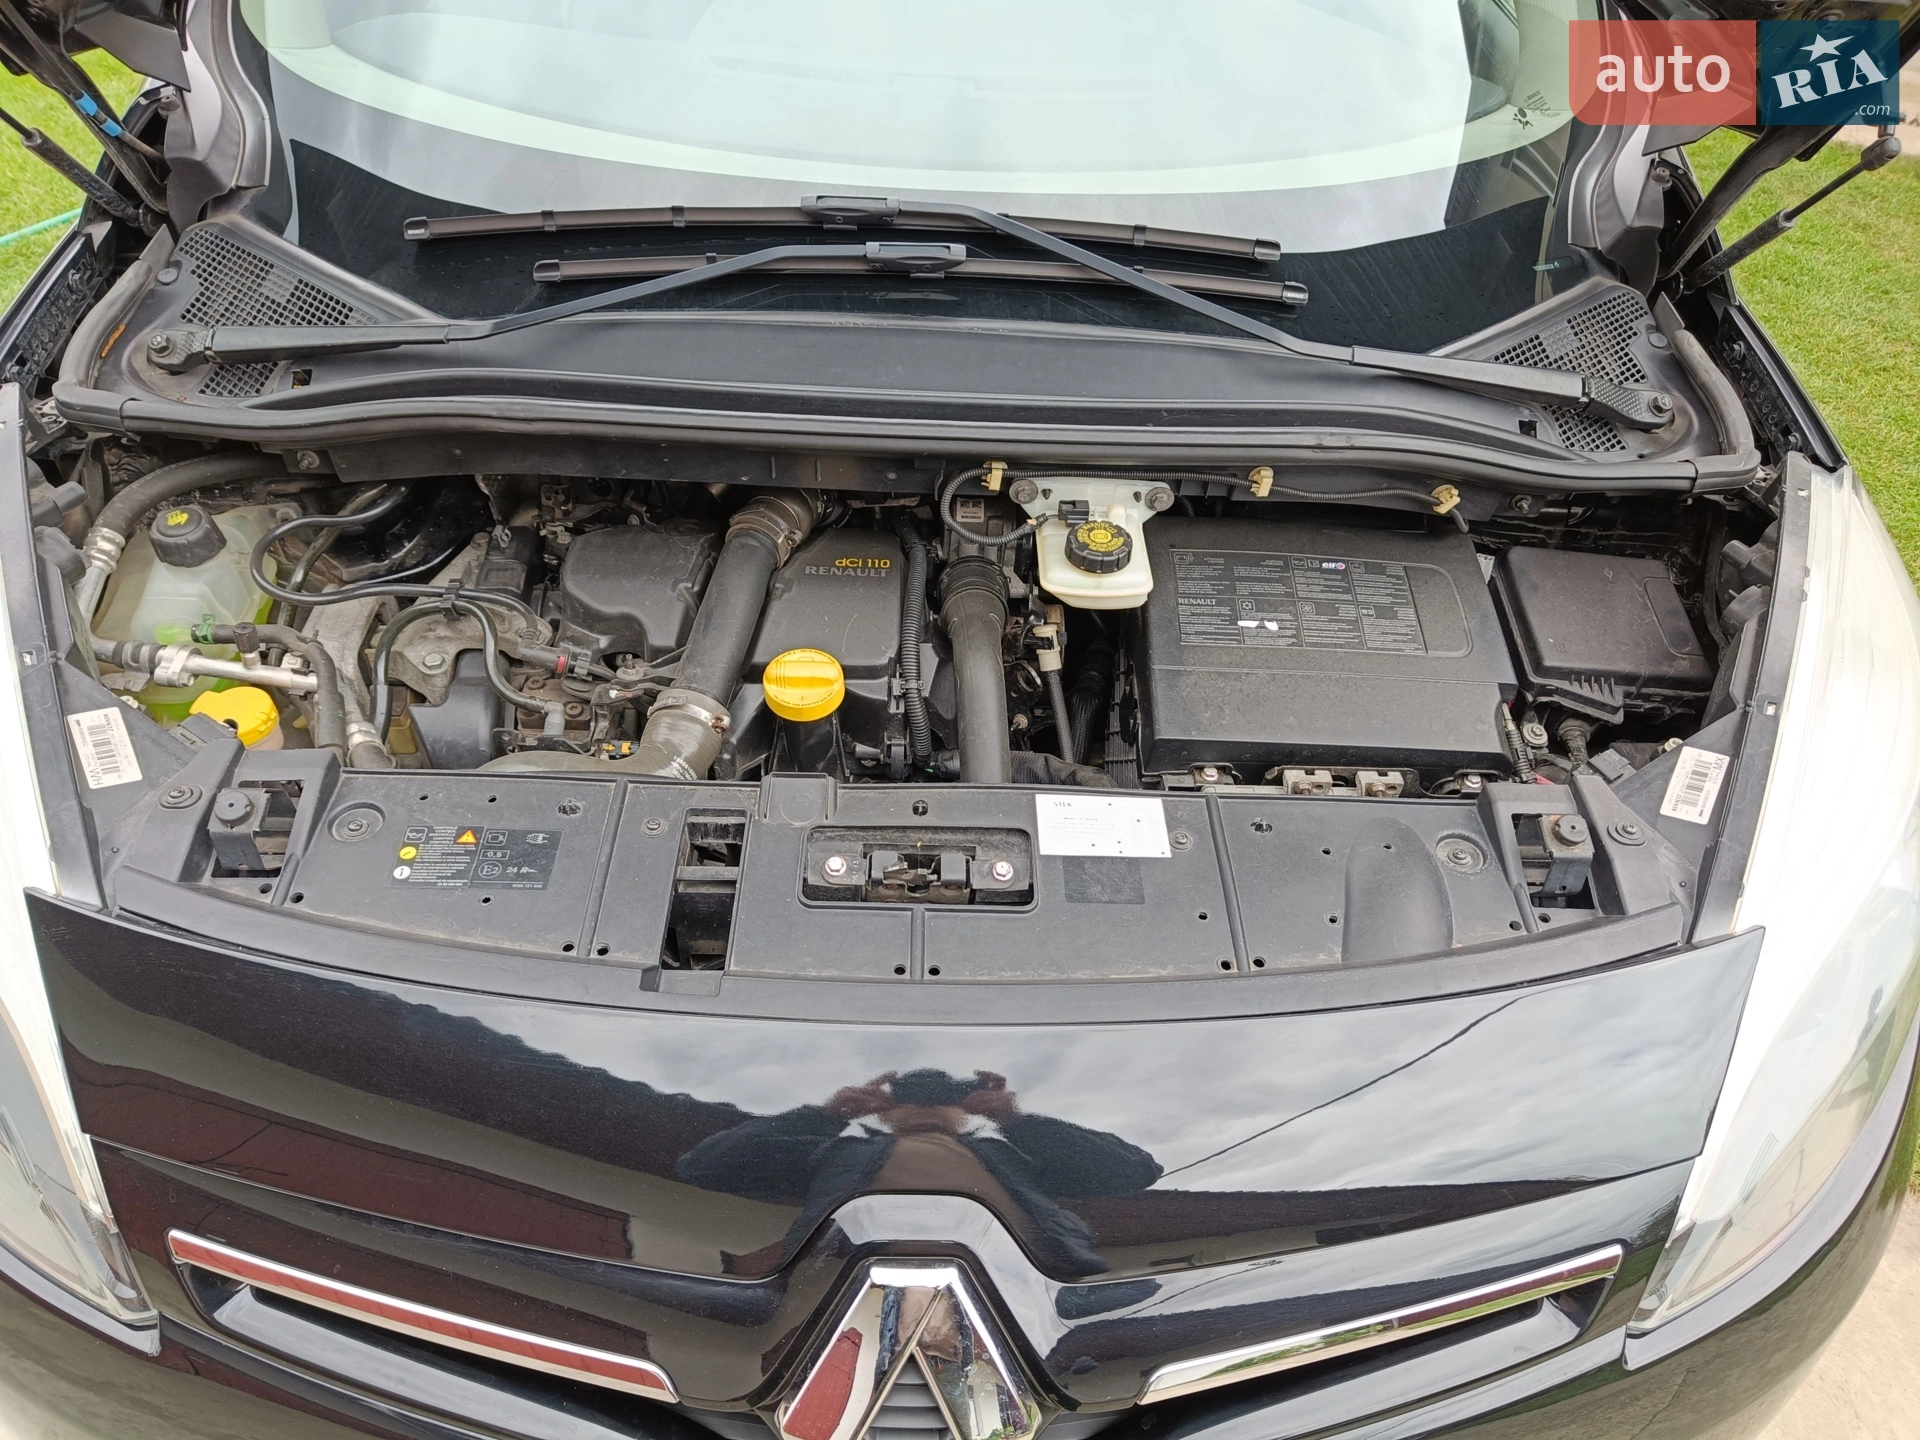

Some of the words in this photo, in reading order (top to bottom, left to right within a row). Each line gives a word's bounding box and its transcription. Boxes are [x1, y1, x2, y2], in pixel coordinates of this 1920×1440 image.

[866, 558, 890, 568] 110
[1322, 562, 1337, 570] elf
[805, 565, 889, 577] RENAULT
[1713, 755, 1725, 771] MX
[90, 767, 104, 787] WH
[482, 865, 499, 875] E2
